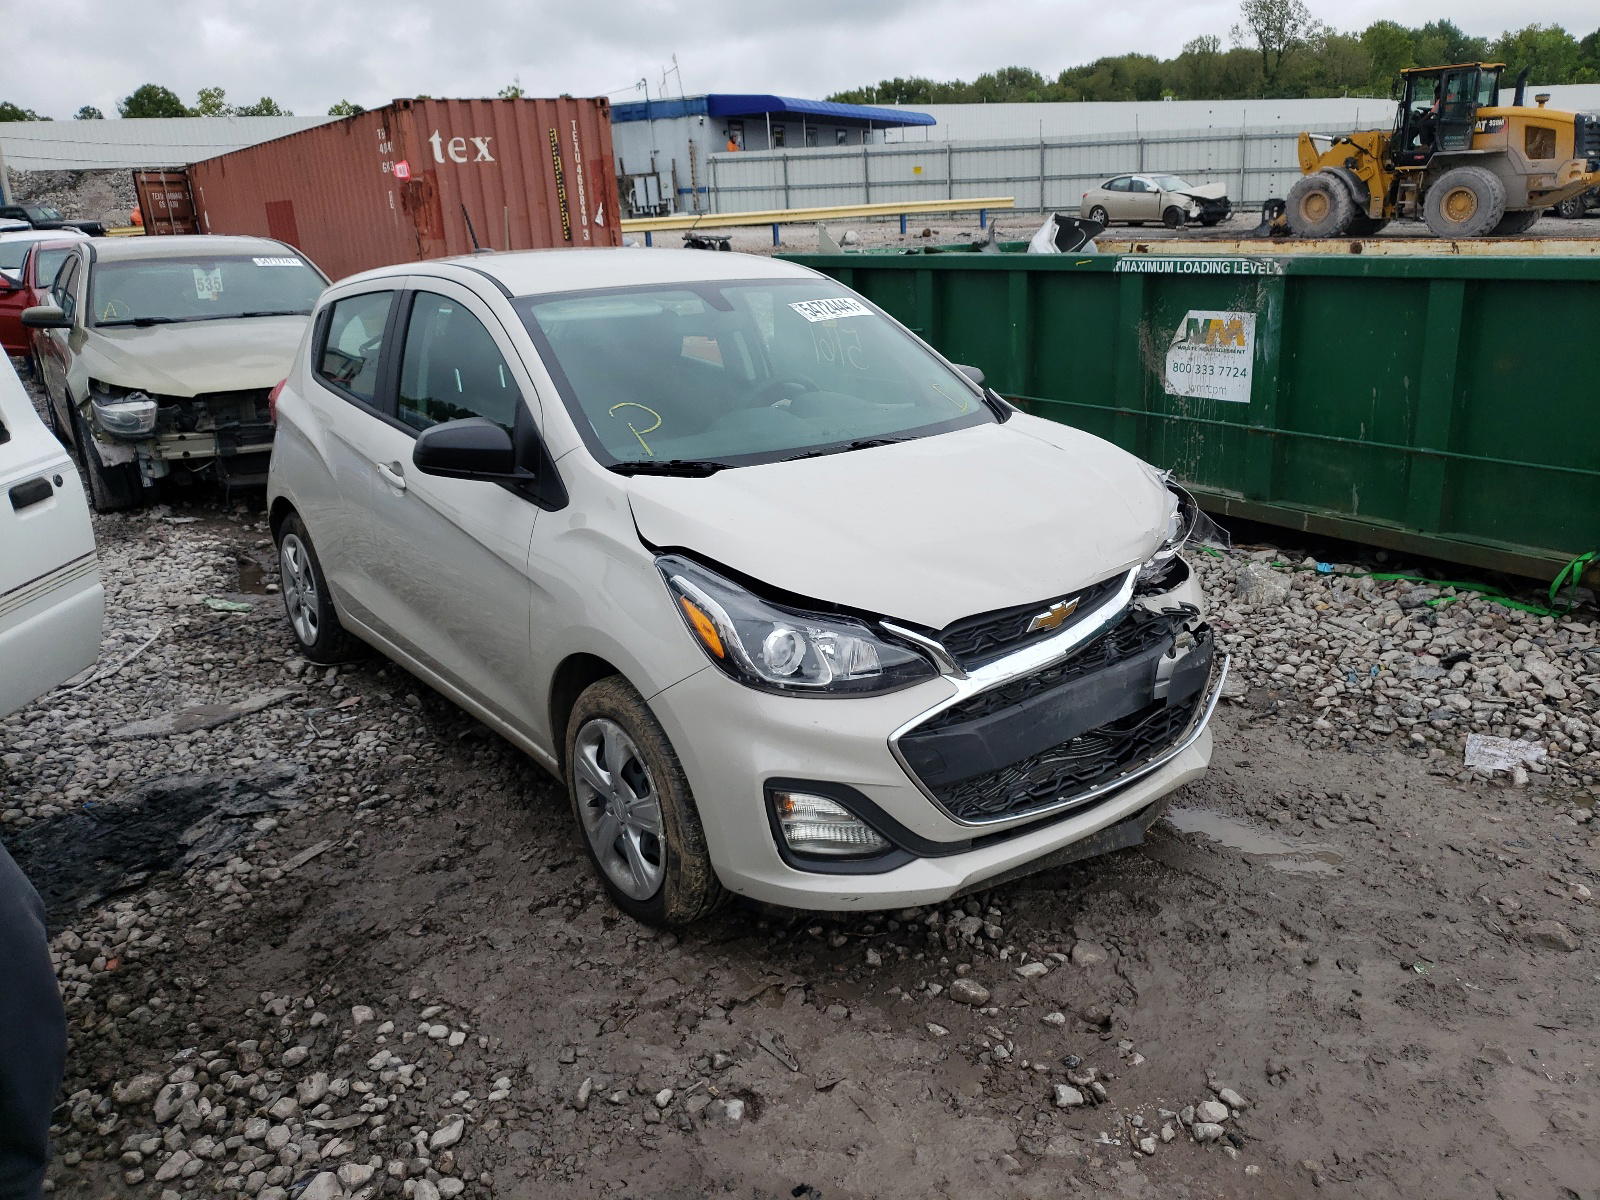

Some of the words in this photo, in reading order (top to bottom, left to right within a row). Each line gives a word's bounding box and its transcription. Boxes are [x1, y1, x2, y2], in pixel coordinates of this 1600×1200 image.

[1474, 119, 1487, 132] AT
[428, 129, 496, 163] tex
[1120, 260, 1173, 273] MAXIMUM
[1177, 261, 1230, 274] LOADING
[1234, 262, 1275, 275] LEVEL
[1173, 363, 1192, 374] 800
[1195, 365, 1215, 376] 333
[1219, 367, 1247, 379] 7724
[608, 402, 662, 456] P
